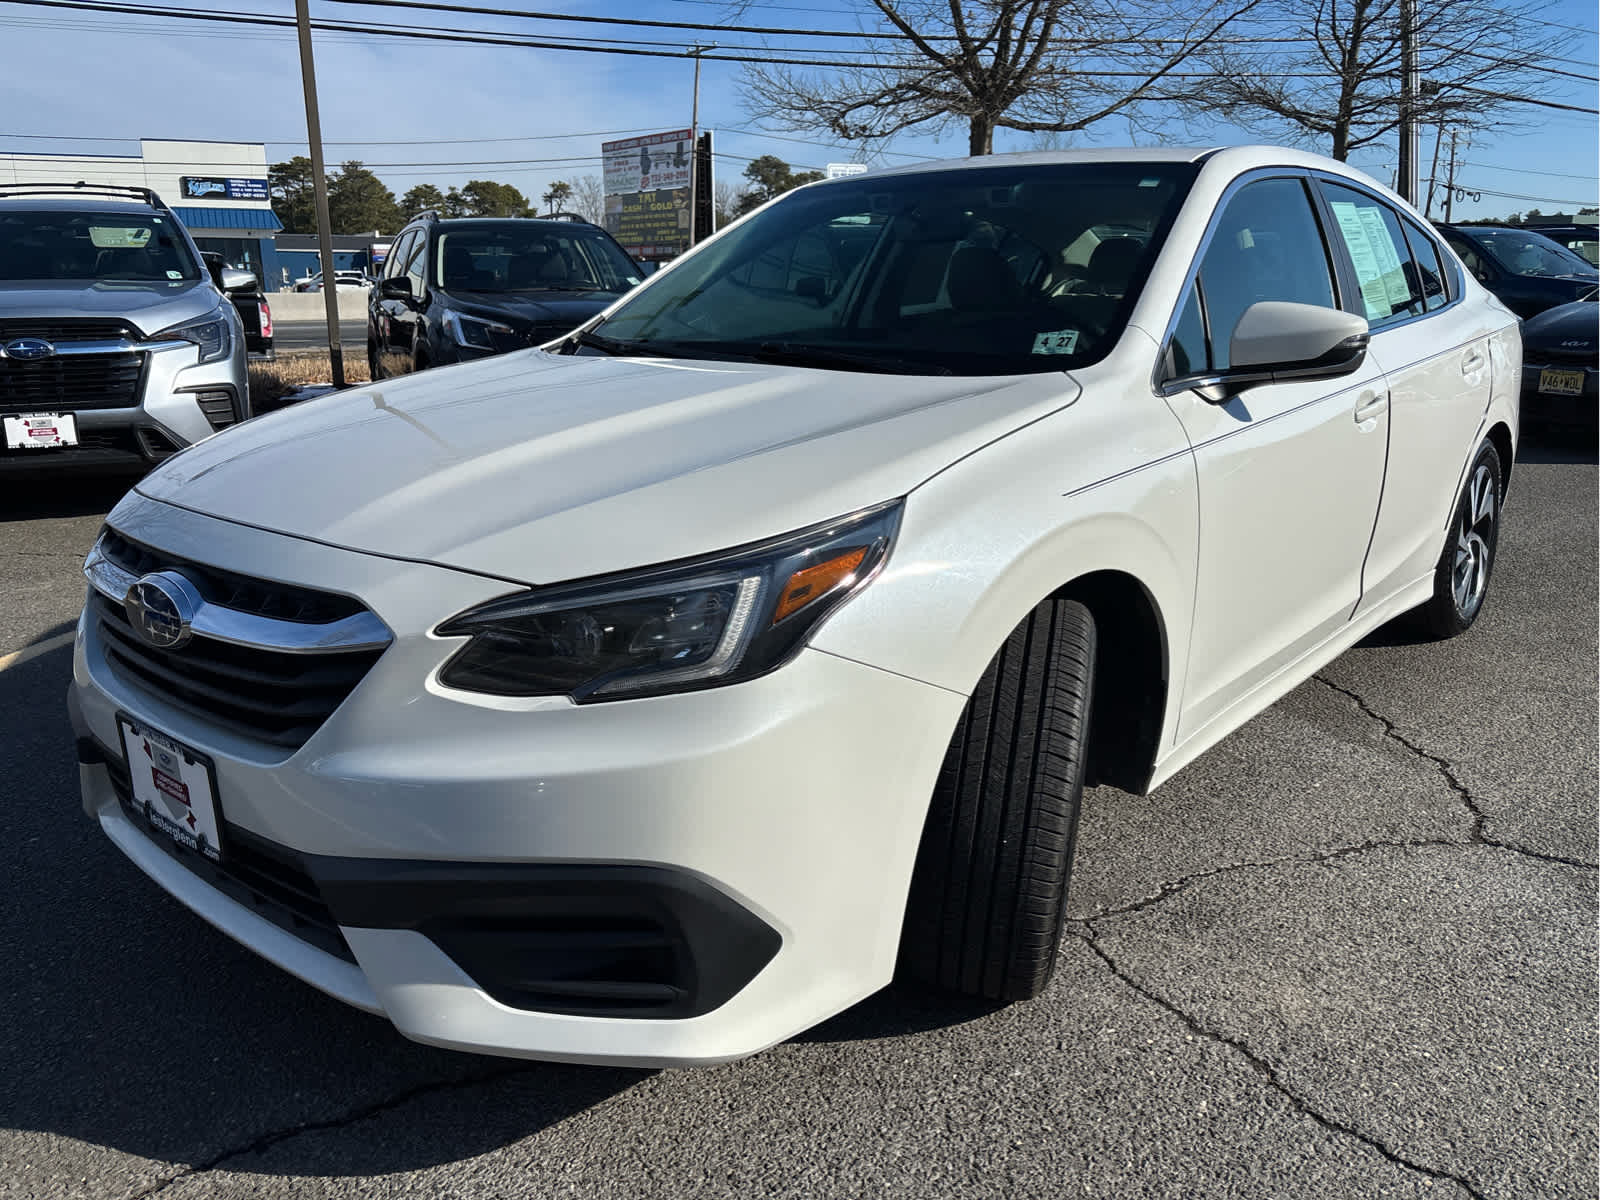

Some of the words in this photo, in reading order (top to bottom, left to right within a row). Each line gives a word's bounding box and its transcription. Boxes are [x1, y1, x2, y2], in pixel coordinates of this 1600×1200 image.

[650, 201, 673, 211] GOLD
[1041, 336, 1049, 347] 4
[1056, 336, 1073, 347] 27
[151, 814, 198, 850] lesterglenn
